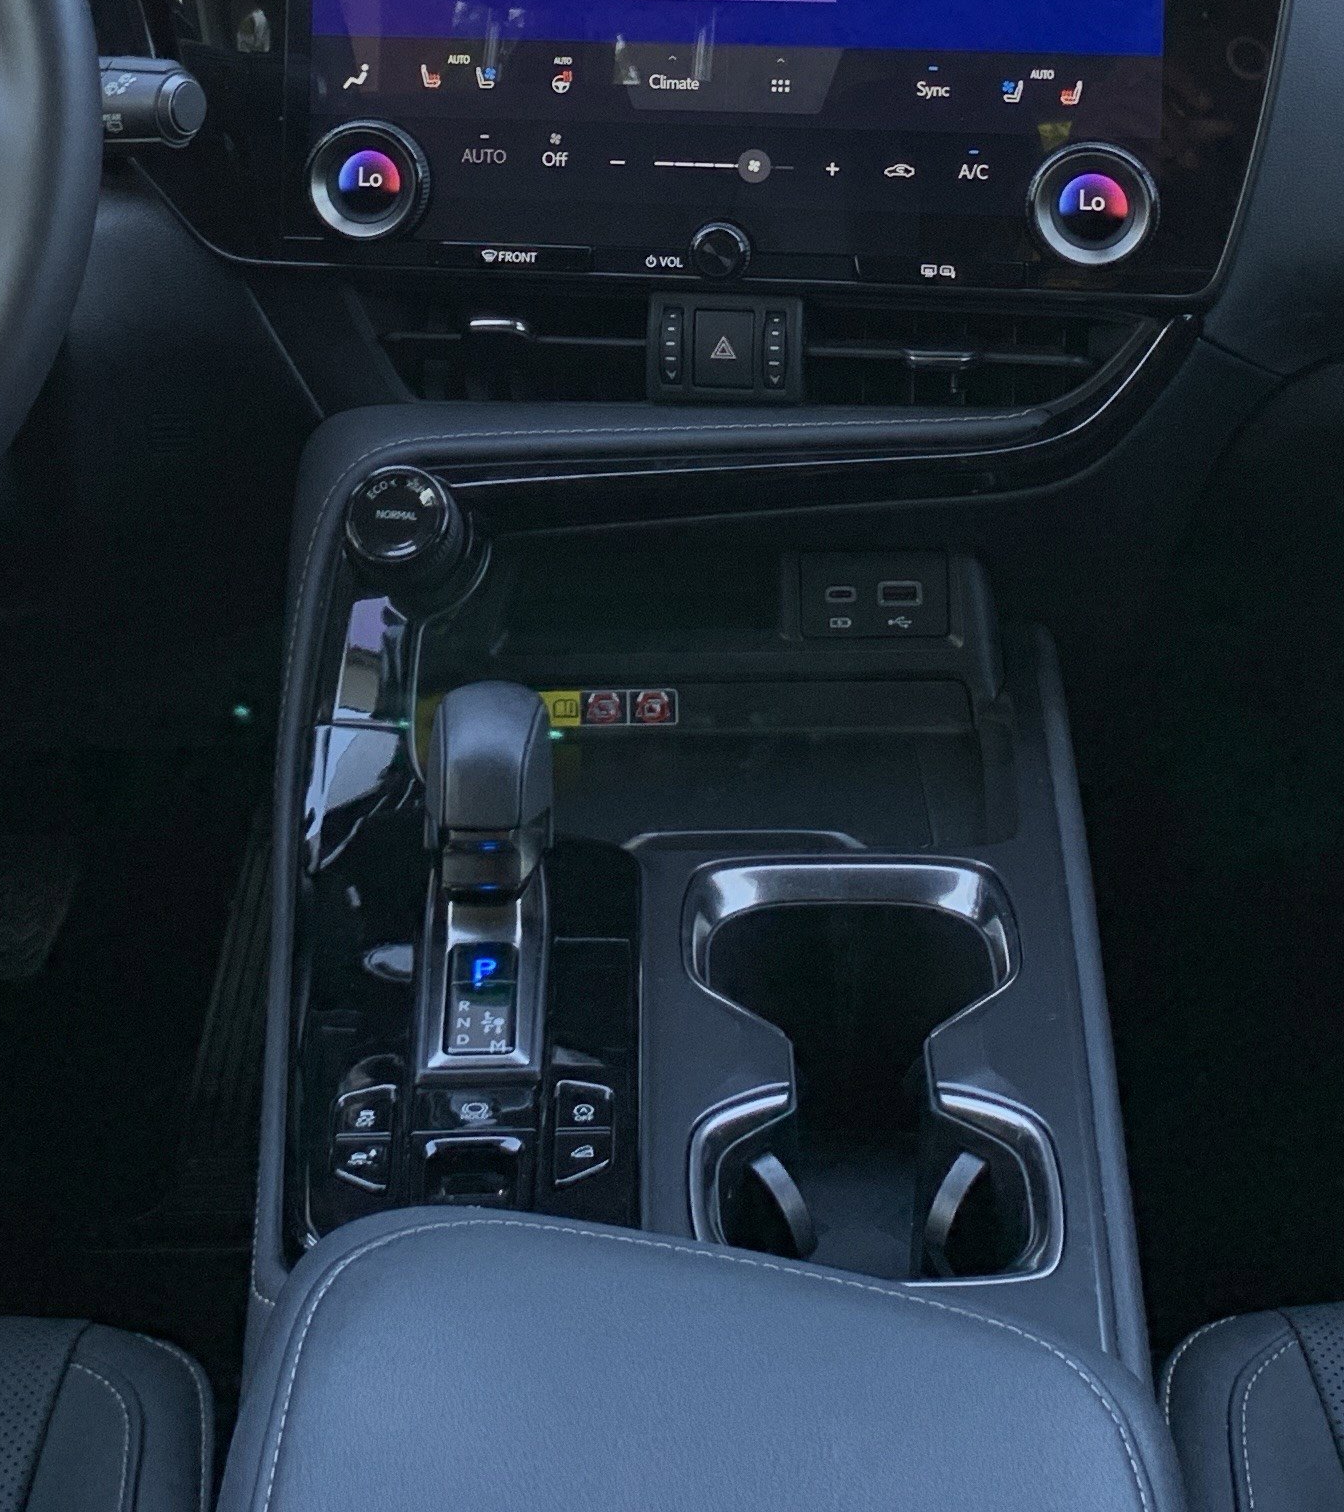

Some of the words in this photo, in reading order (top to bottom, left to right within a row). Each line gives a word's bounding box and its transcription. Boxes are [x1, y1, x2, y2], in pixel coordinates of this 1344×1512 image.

[448, 55, 470, 65] AUTO
[554, 57, 572, 65] AUTO
[1030, 69, 1055, 80] AUTO
[649, 75, 699, 91] Climate
[916, 81, 950, 99] Sync
[461, 148, 507, 164] AUTO
[542, 151, 568, 167] Off
[358, 166, 383, 188] Lo
[958, 163, 989, 181] A/C
[1079, 190, 1106, 212] Lo
[498, 251, 537, 264] FRONT
[659, 256, 683, 269] VOL
[366, 480, 389, 499] ECO
[376, 510, 417, 520] NORMAL
[473, 957, 497, 981] P
[459, 1000, 471, 1012] R
[458, 1017, 470, 1028] N
[457, 1034, 470, 1046] D
[490, 1039, 506, 1053] M
